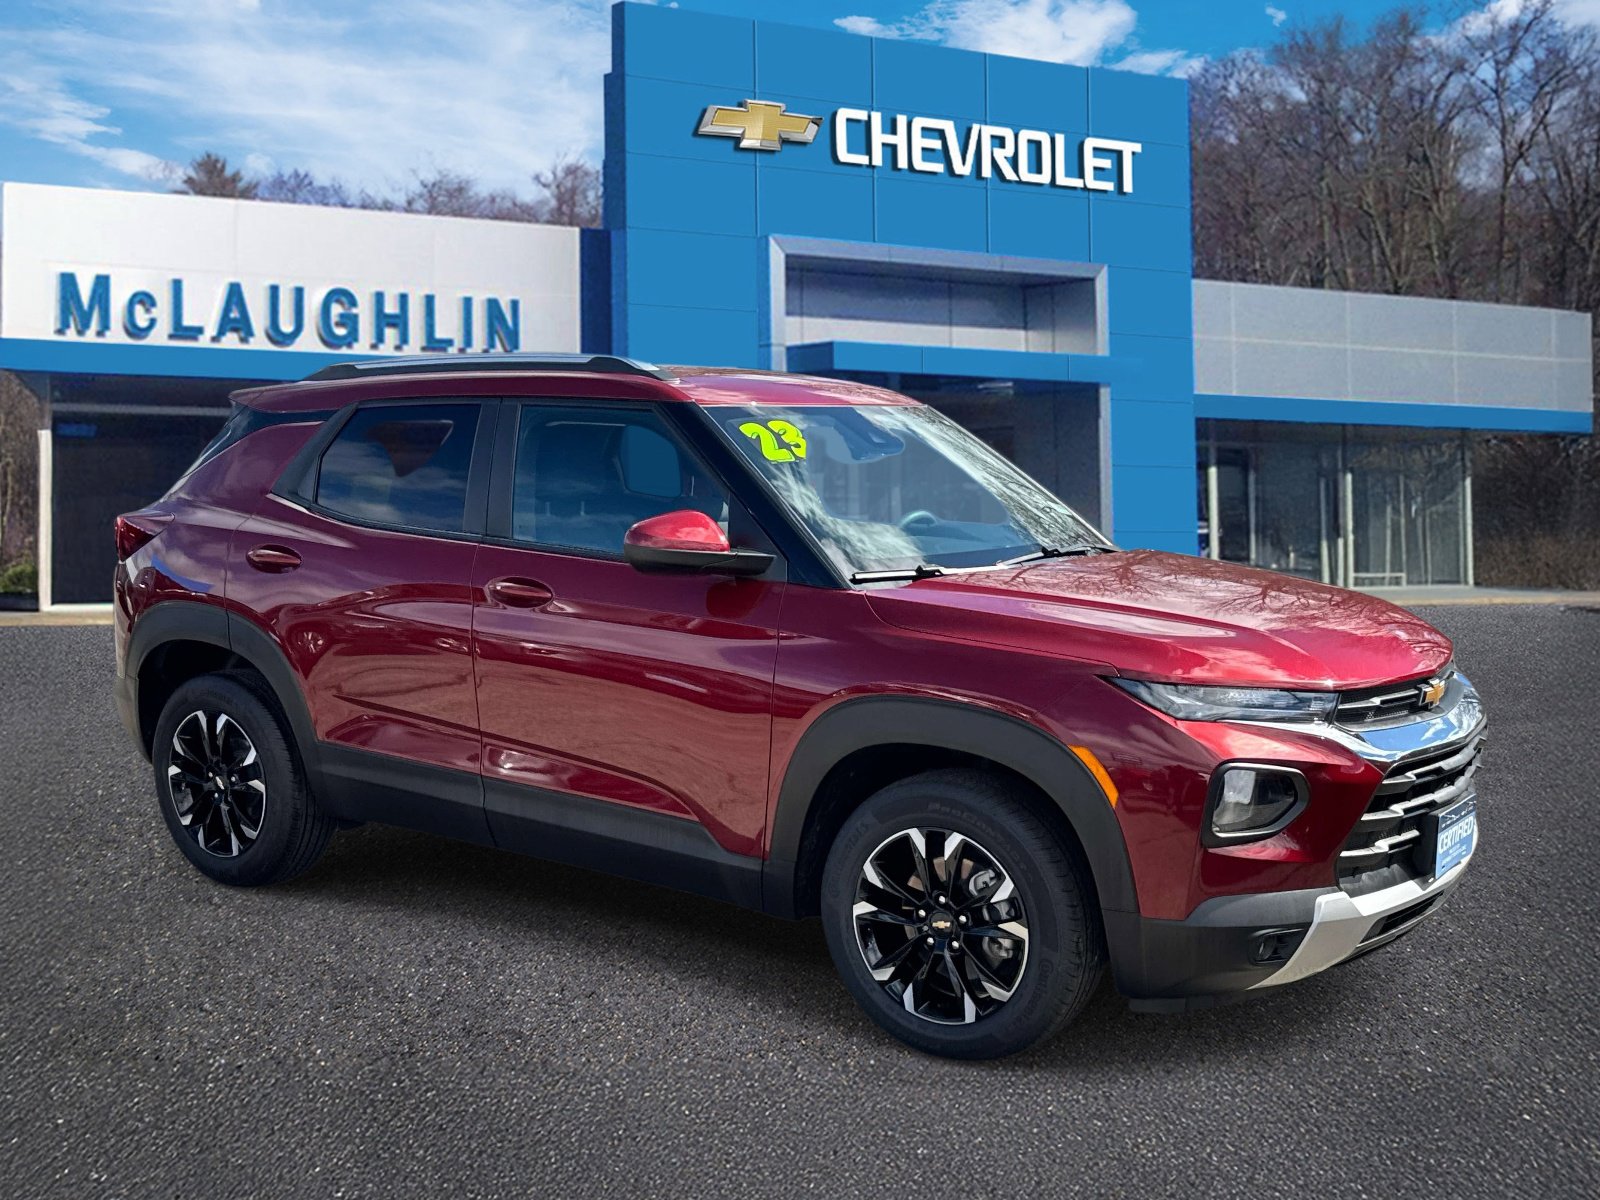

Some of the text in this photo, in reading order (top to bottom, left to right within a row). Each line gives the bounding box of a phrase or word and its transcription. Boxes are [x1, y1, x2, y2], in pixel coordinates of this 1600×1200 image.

[834, 107, 1142, 193] CHEVROLET
[55, 272, 521, 352] McLAUGHLIN
[739, 420, 806, 463] 23
[1439, 816, 1474, 854] CERTIFIED
